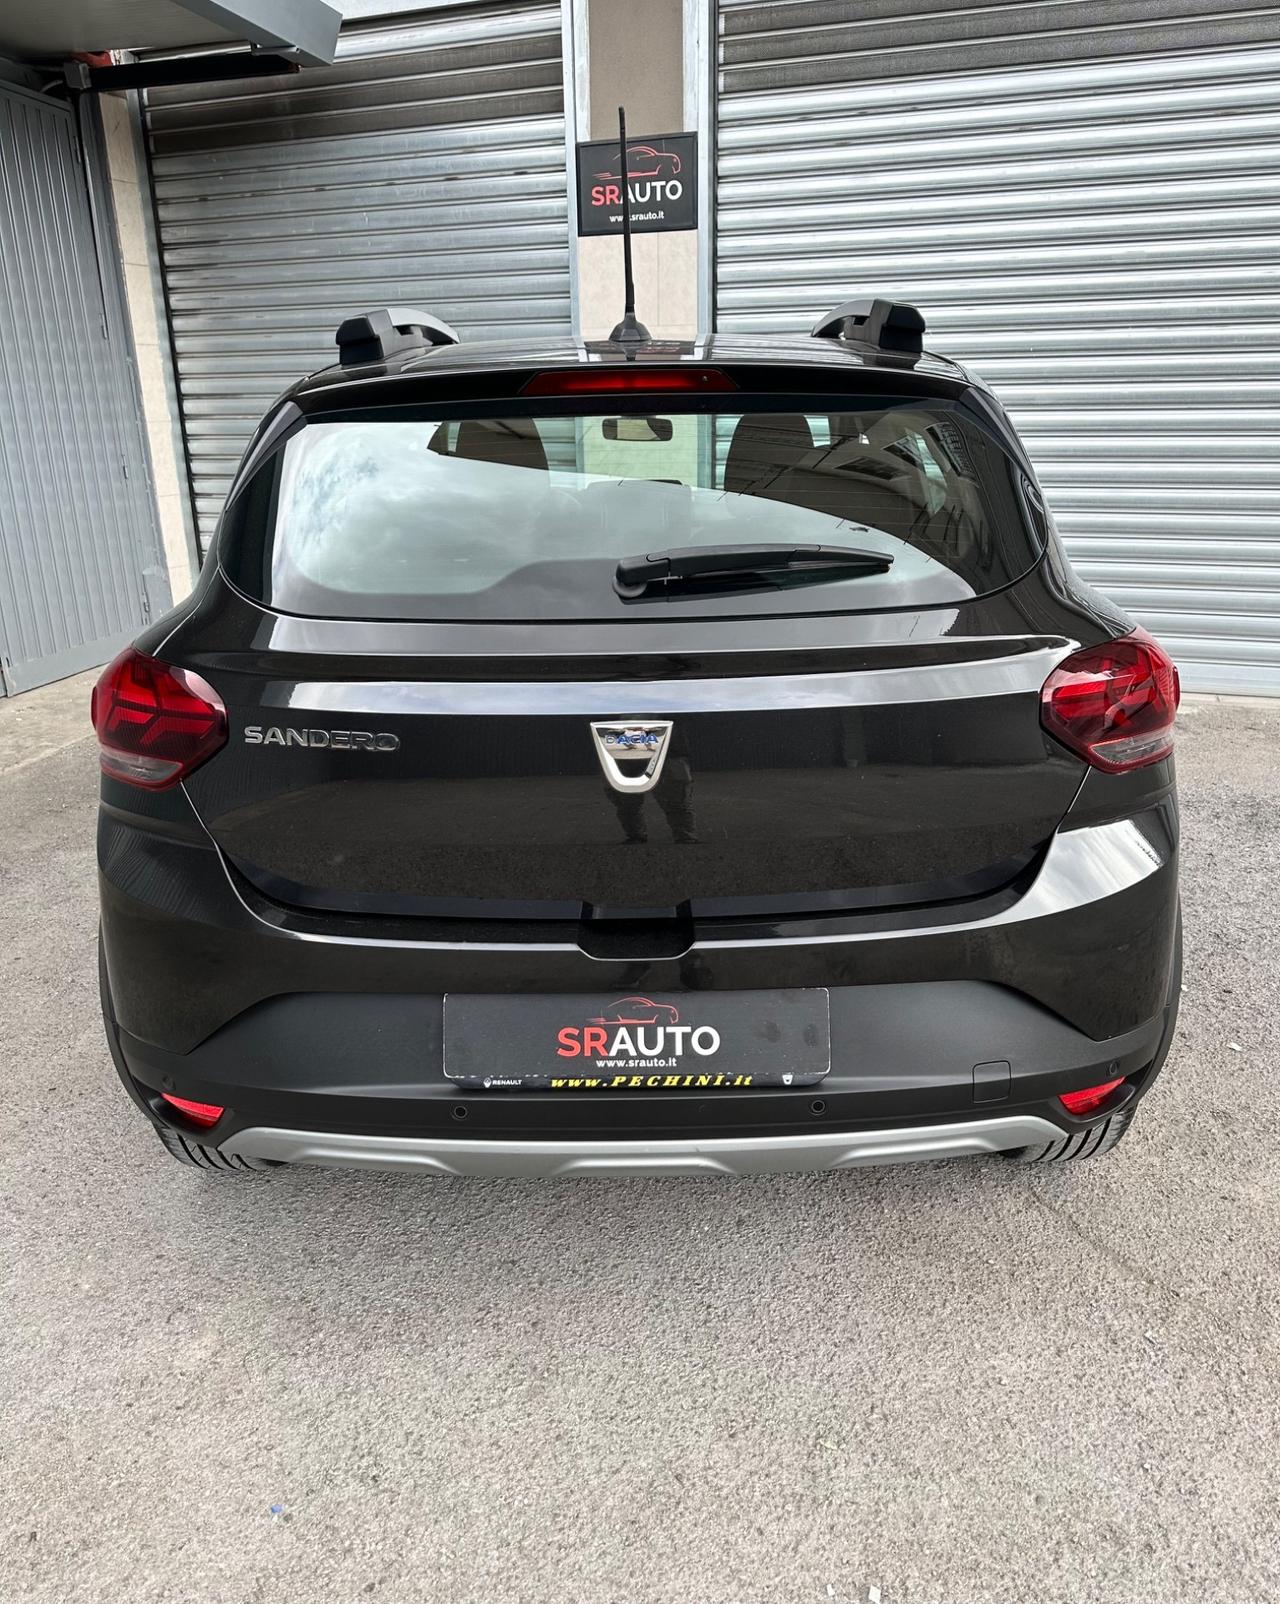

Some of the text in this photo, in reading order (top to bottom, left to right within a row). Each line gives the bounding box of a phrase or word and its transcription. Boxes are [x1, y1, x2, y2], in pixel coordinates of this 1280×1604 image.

[609, 210, 665, 222] ww.srauto.it
[244, 726, 400, 751] SANDERO
[605, 733, 658, 744] DACIA
[557, 1026, 721, 1057] SRAUTO
[595, 1057, 677, 1068] www.srauto.it
[551, 1074, 753, 1088] www.PECHINI.it
